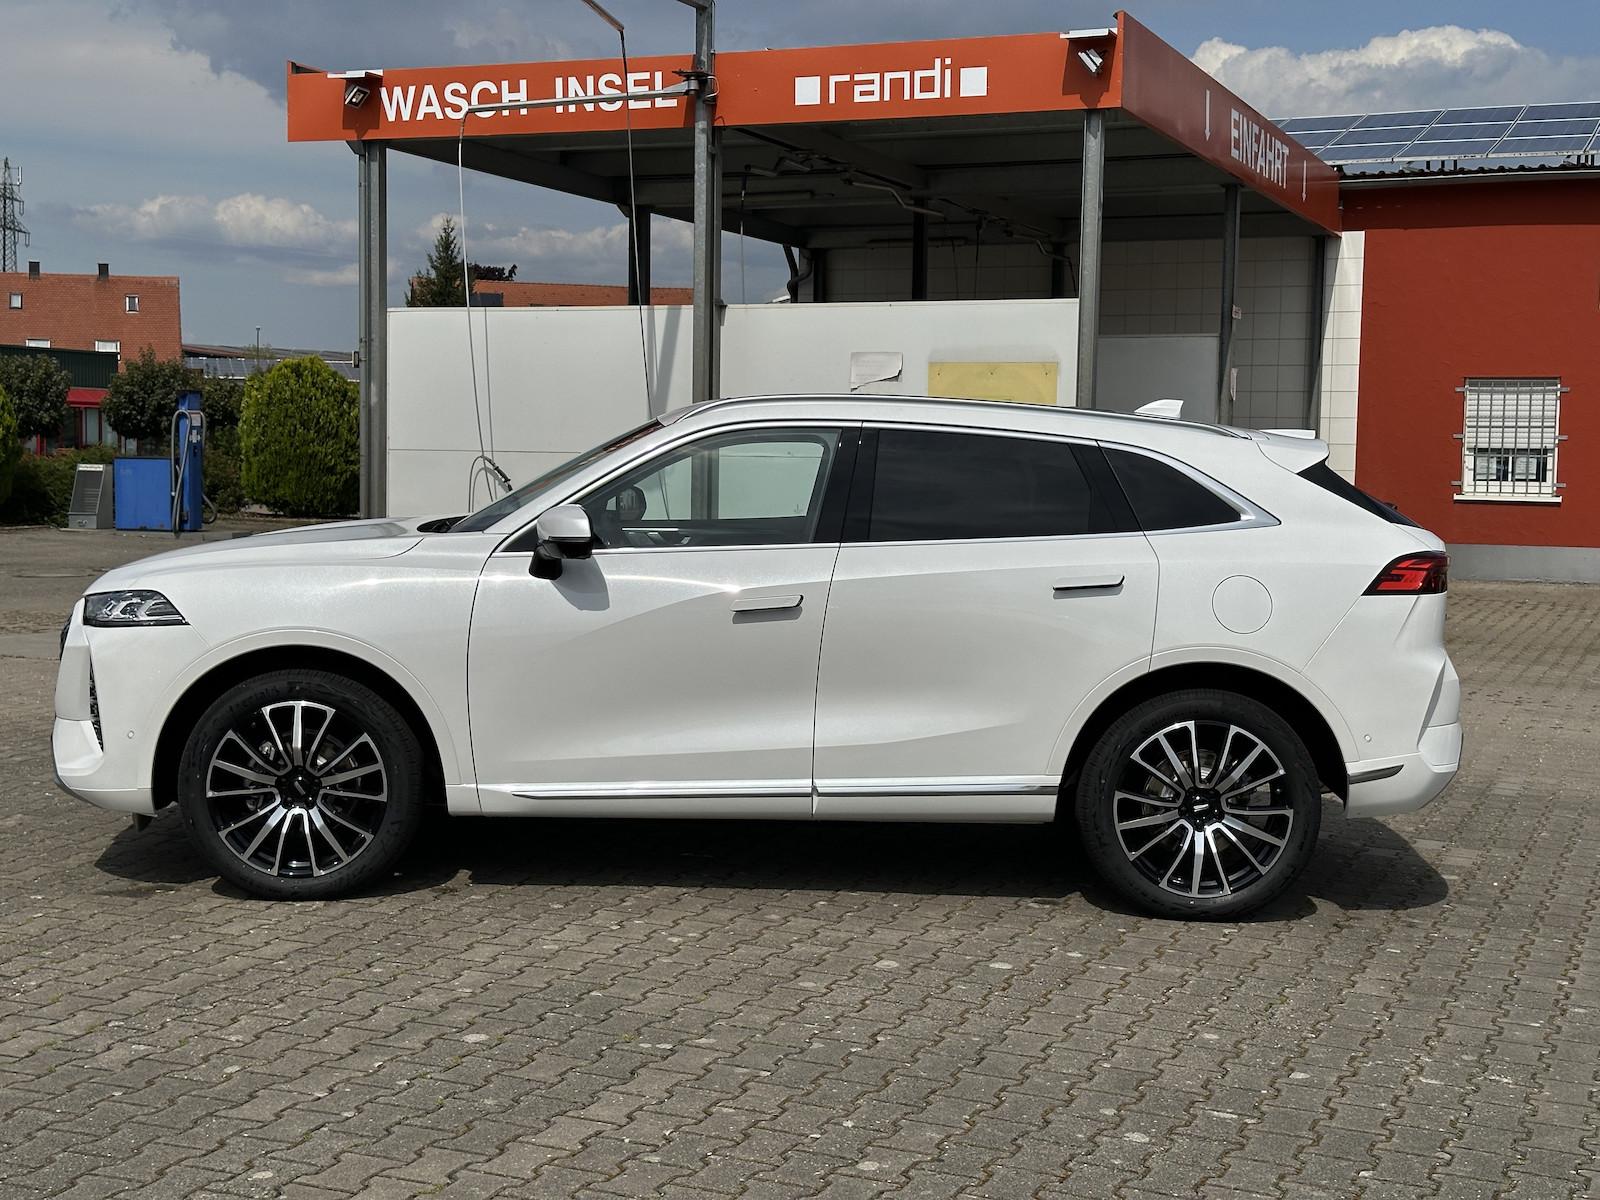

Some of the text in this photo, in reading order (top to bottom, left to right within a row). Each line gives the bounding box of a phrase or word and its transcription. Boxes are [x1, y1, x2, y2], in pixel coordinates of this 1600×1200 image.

[380, 71, 678, 122] WASCH INSEL
[829, 58, 951, 104] randi
[1230, 108, 1290, 189] EINFAHRT
